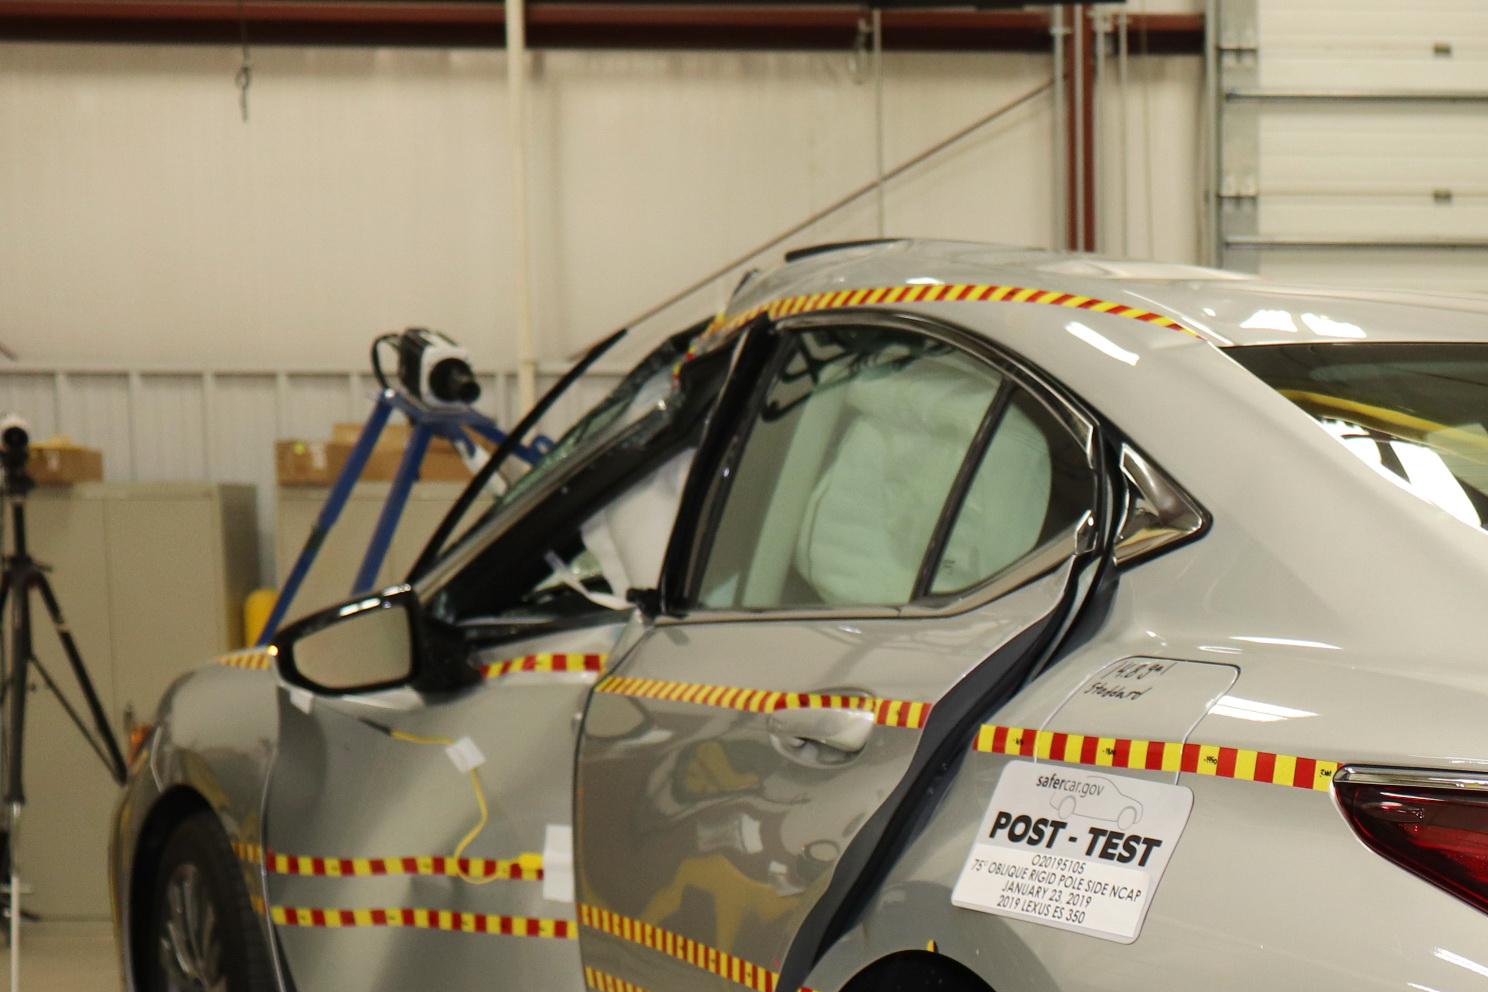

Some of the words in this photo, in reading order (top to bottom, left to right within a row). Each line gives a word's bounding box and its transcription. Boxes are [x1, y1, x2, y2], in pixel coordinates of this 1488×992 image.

[1036, 773, 1105, 798] safercar.gov
[988, 811, 1068, 849] POST
[1085, 826, 1163, 867] TEST
[988, 861, 1029, 880] OBLIQUE
[1029, 871, 1057, 885] RIGID
[1059, 875, 1084, 891] POLE
[1085, 879, 1110, 896] SIDE
[1109, 885, 1142, 902] NCAP
[1002, 880, 1049, 901] JANUARY
[1049, 889, 1063, 904] 23,
[1065, 892, 1092, 908] 2019
[997, 895, 1021, 910] 2019
[1021, 899, 1050, 918] LEXUS
[1051, 906, 1064, 920] ES
[1065, 910, 1086, 924] 350
